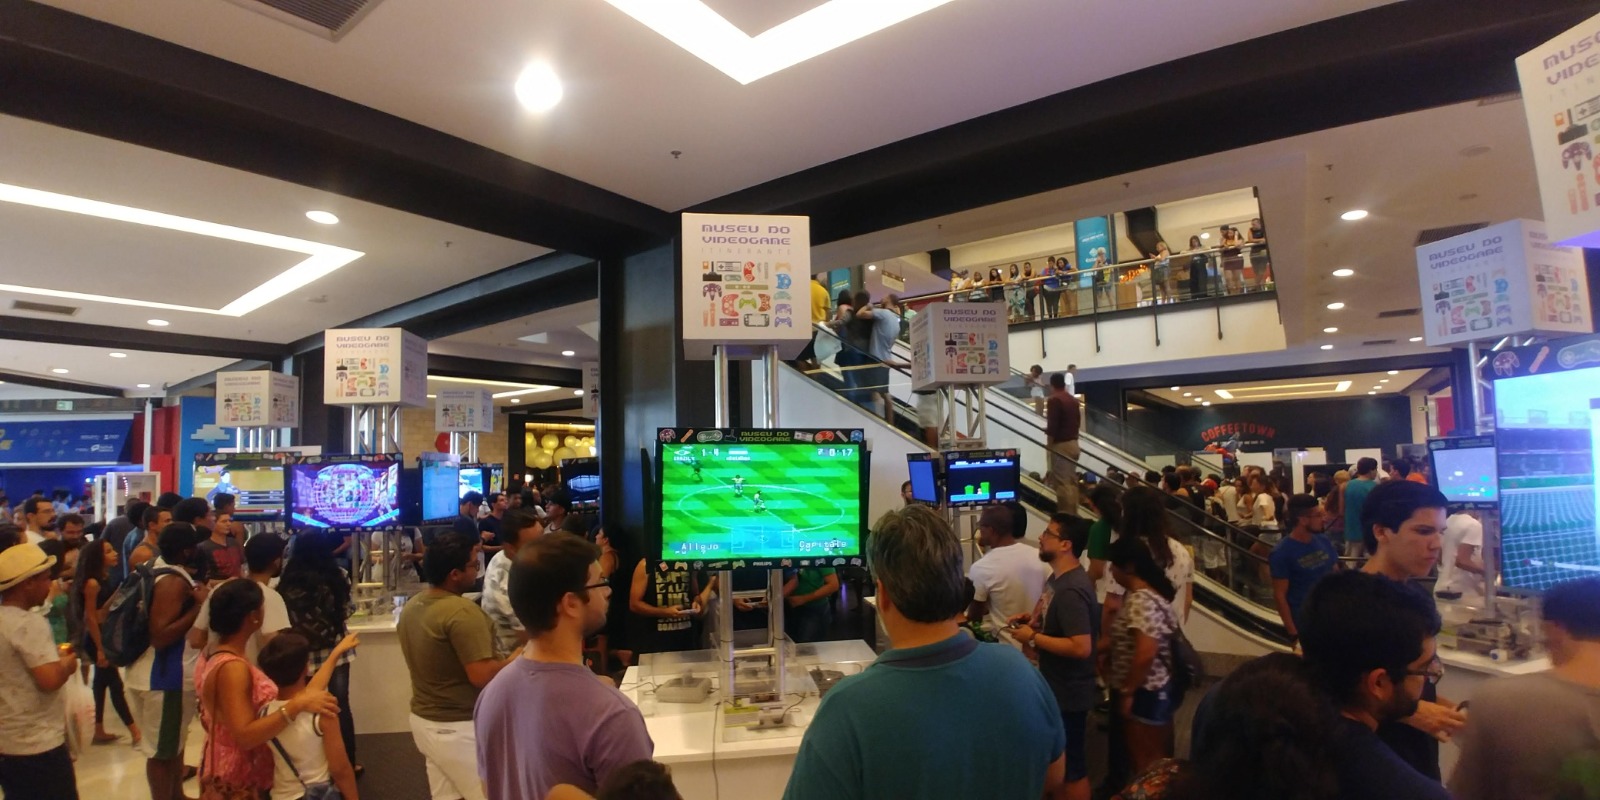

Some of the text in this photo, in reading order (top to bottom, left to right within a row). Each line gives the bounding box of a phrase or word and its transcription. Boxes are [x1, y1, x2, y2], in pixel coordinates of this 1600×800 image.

[701, 224, 791, 234] MUSEU DO
[701, 236, 791, 245] VIDEOGAME
[701, 247, 792, 256] ITINERANTE
[1428, 236, 1503, 262] MUSEU DO
[1430, 246, 1503, 270] VIDEOGAME
